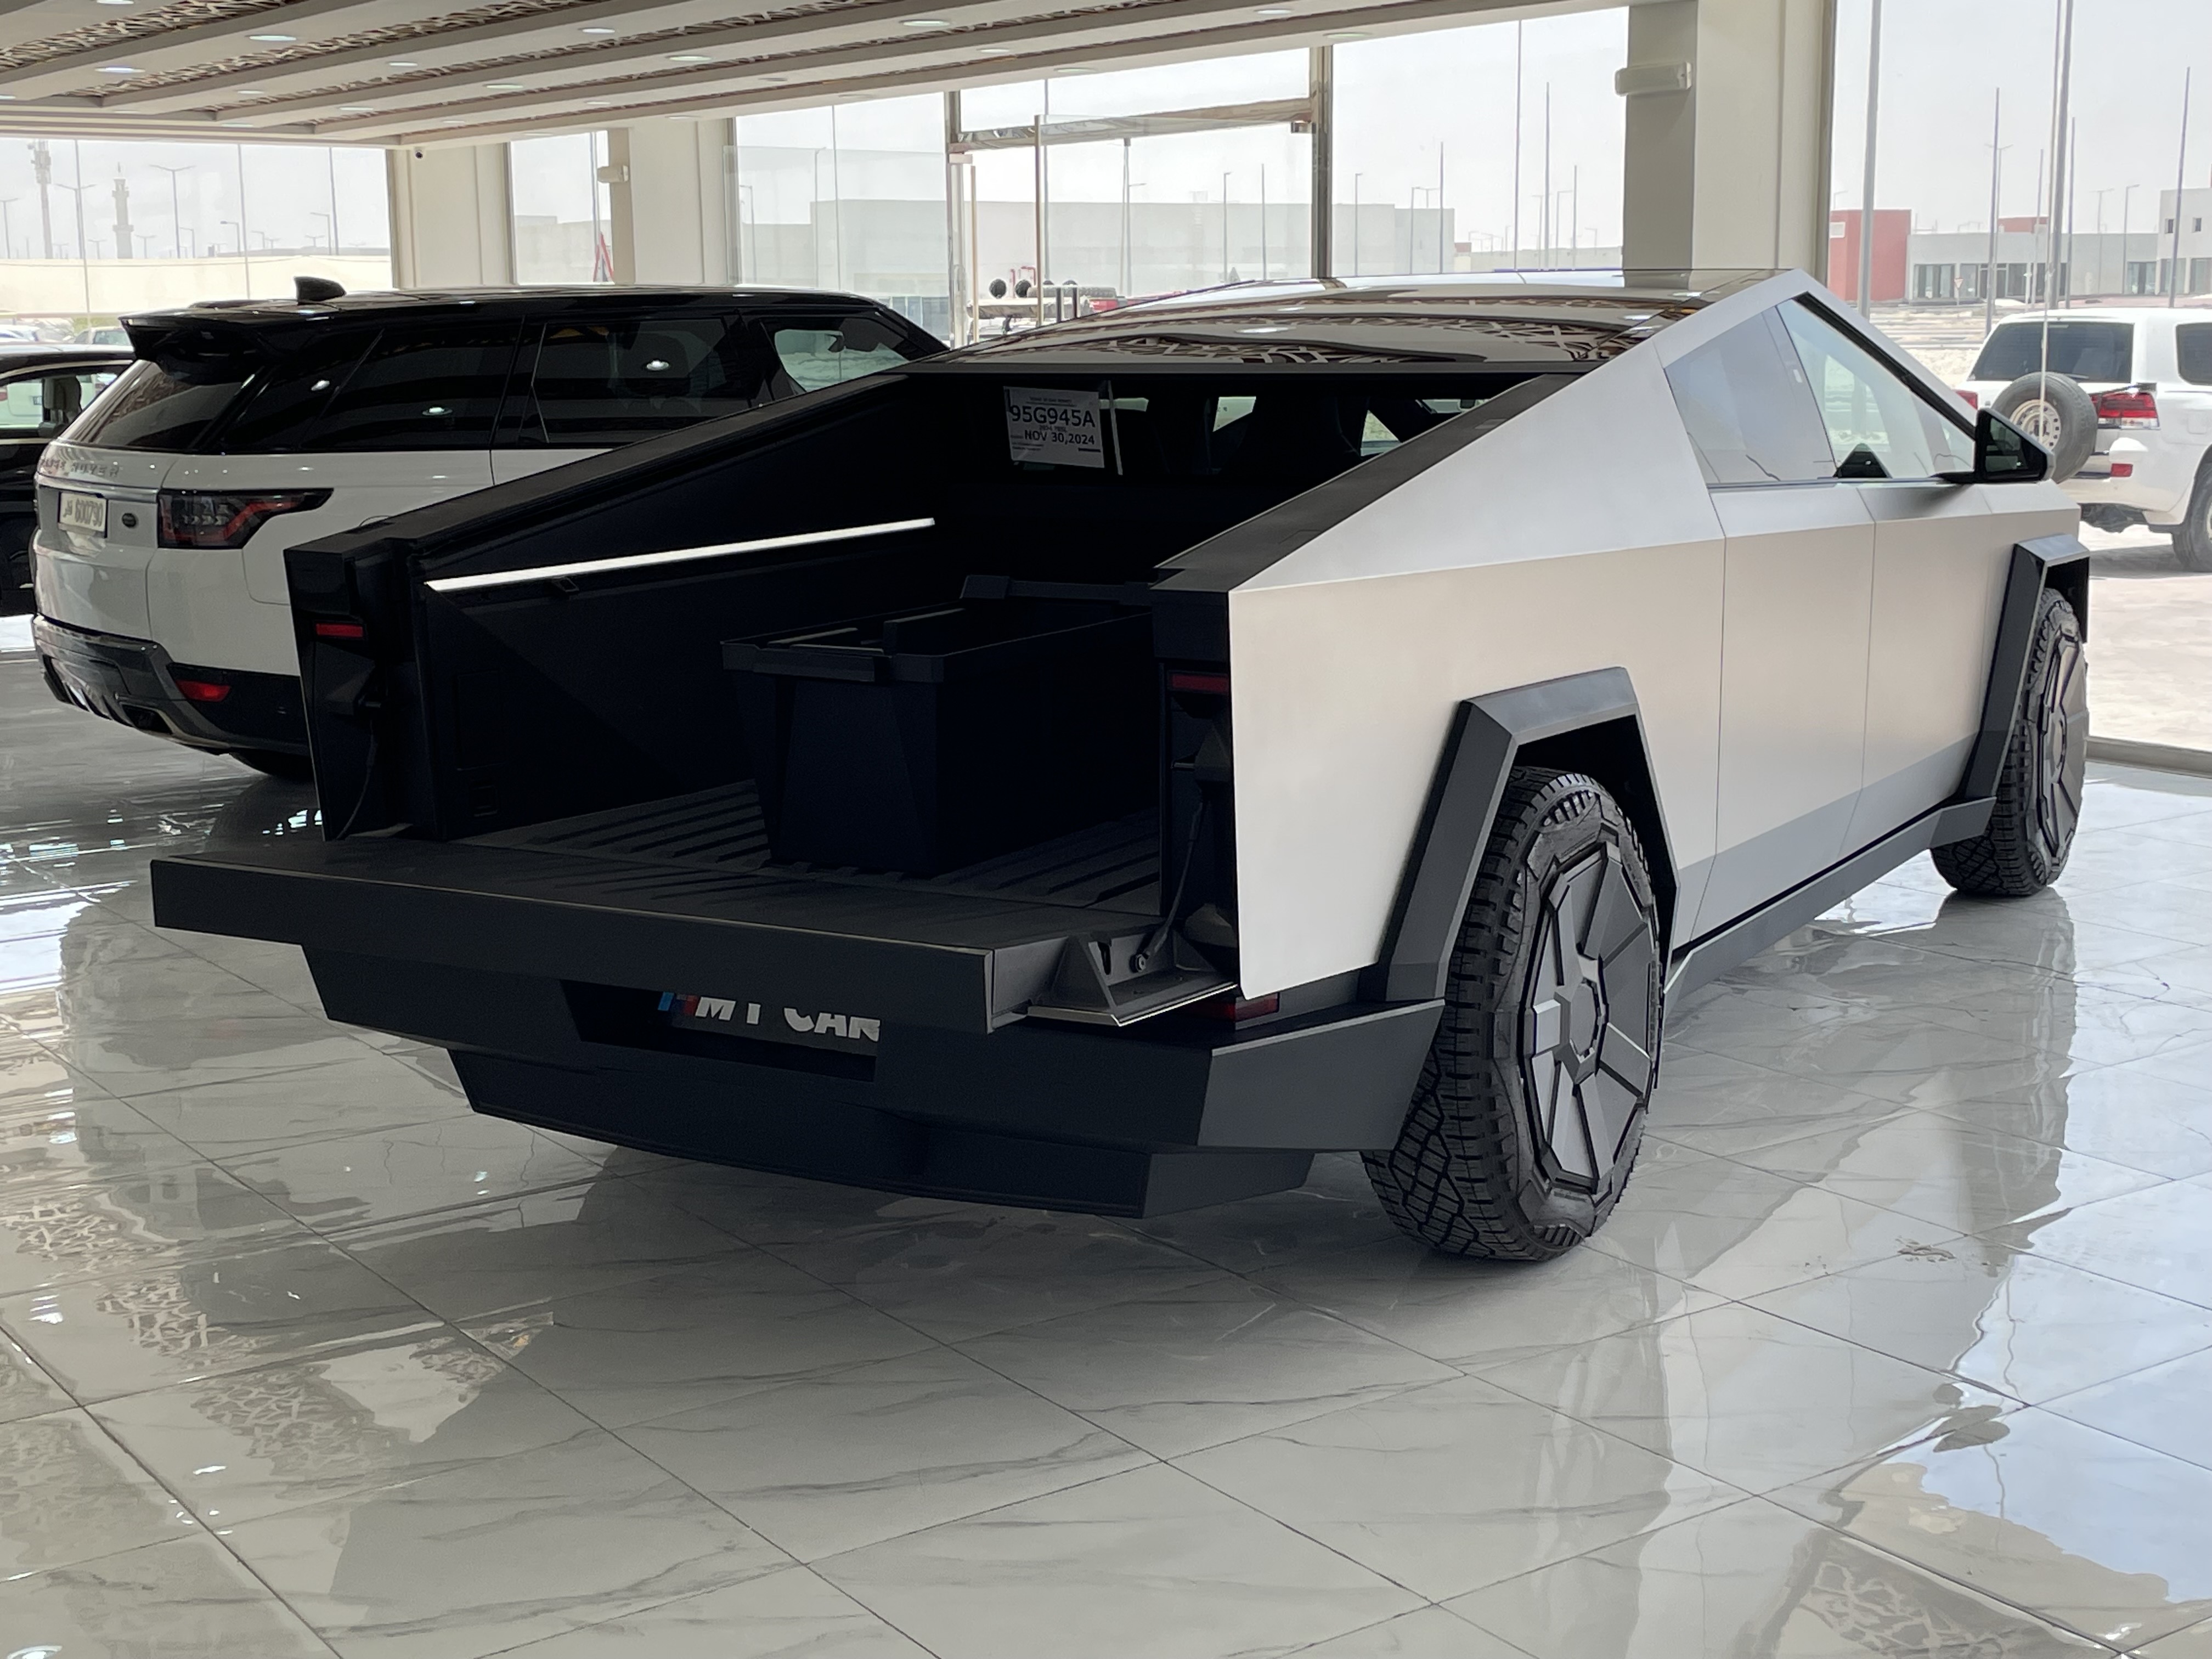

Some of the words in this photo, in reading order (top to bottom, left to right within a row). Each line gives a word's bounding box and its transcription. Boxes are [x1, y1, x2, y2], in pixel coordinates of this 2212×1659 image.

[1010, 405, 1096, 428] 95G945A
[1024, 430, 1047, 441] NOV
[1051, 432, 1095, 445] 30,2024
